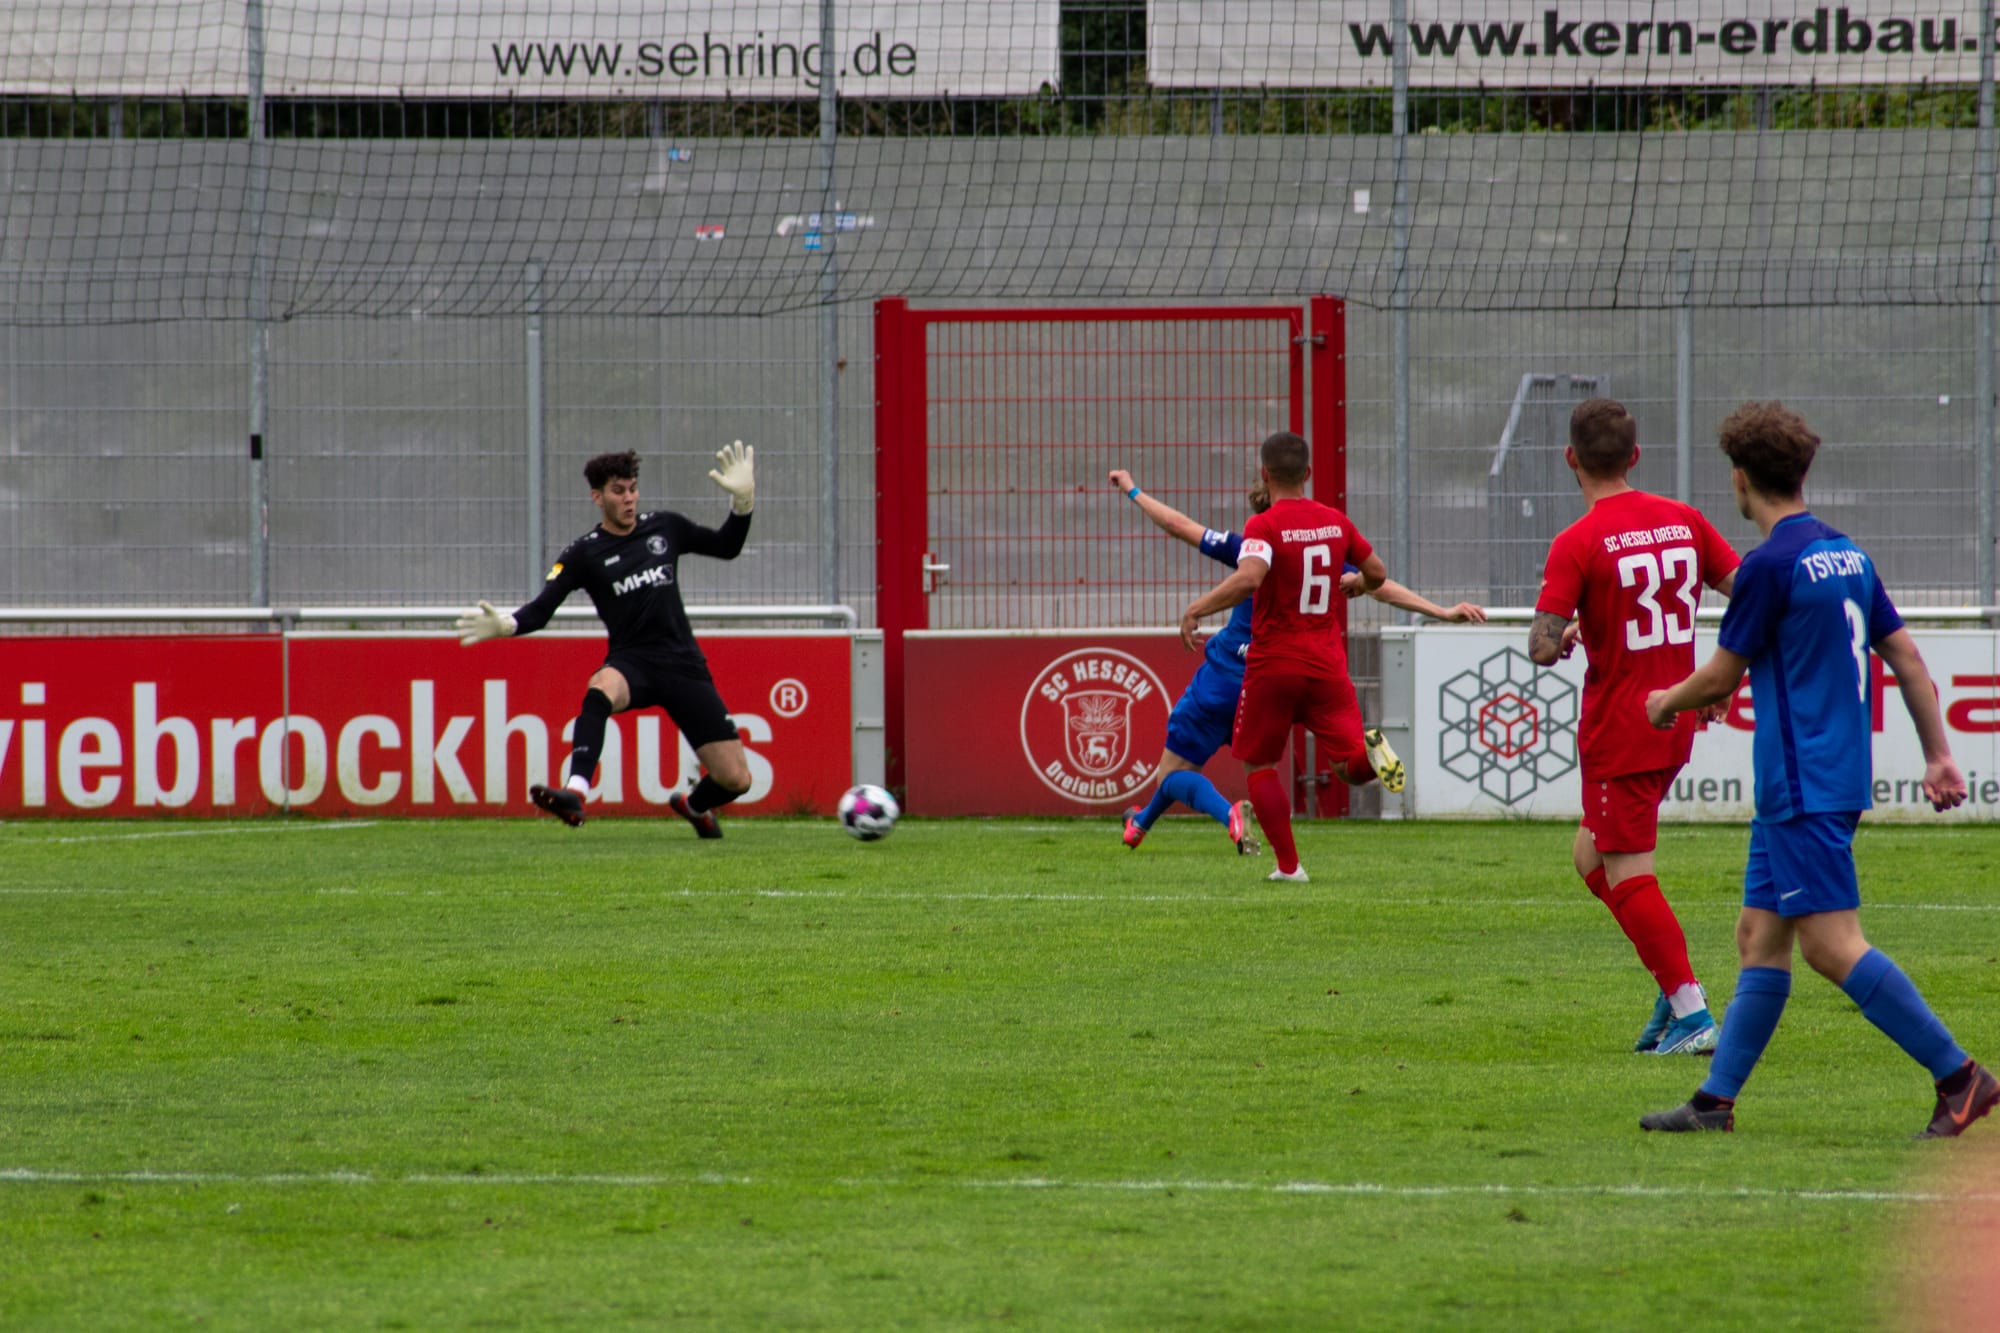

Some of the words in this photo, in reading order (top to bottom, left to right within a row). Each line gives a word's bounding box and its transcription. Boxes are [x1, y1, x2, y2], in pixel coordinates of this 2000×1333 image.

[1347, 8, 2000, 57] www.kern-erdbau.
[492, 32, 917, 88] www.sehring.de
[1281, 529, 1293, 543] SC
[1292, 528, 1317, 543] HESSEN
[1604, 535, 1621, 553] SC
[1619, 529, 1655, 549] HESSEN
[1653, 524, 1693, 544] DREIEICH
[612, 566, 666, 596] MHK
[1299, 544, 1331, 615] 6
[1801, 551, 1835, 583] TSV
[1617, 547, 1698, 651] 33
[1040, 672, 1069, 701] SC
[1072, 659, 1153, 701] HESSEN
[0, 681, 773, 809] iebrockhaus
[1123, 760, 1153, 788] e.V.
